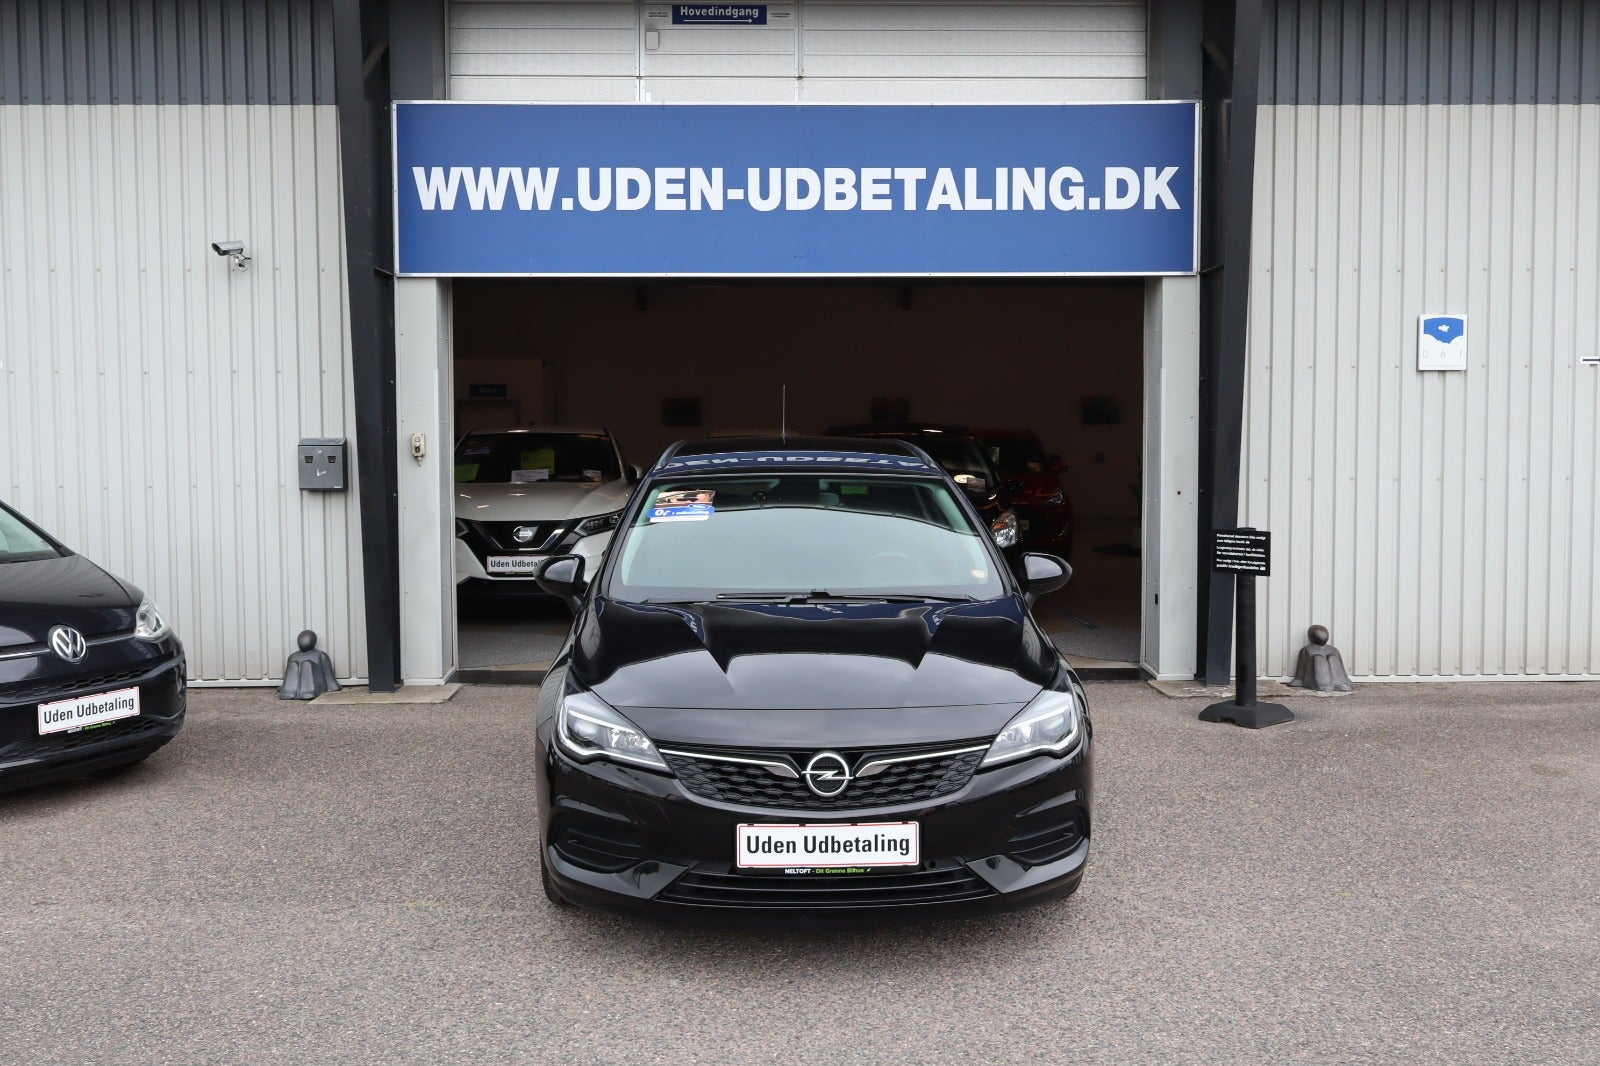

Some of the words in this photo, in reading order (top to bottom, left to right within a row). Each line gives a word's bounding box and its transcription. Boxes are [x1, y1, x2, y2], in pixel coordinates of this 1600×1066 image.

[680, 6, 759, 18] Hovedindgang
[412, 166, 1181, 213] WWW.UDEN-UDBETALING.DK
[490, 560, 510, 568] Uden
[44, 709, 73, 724] Uden
[76, 697, 135, 718] Udbetaling
[746, 835, 797, 854] Uden
[803, 834, 910, 856] Udbetaling
